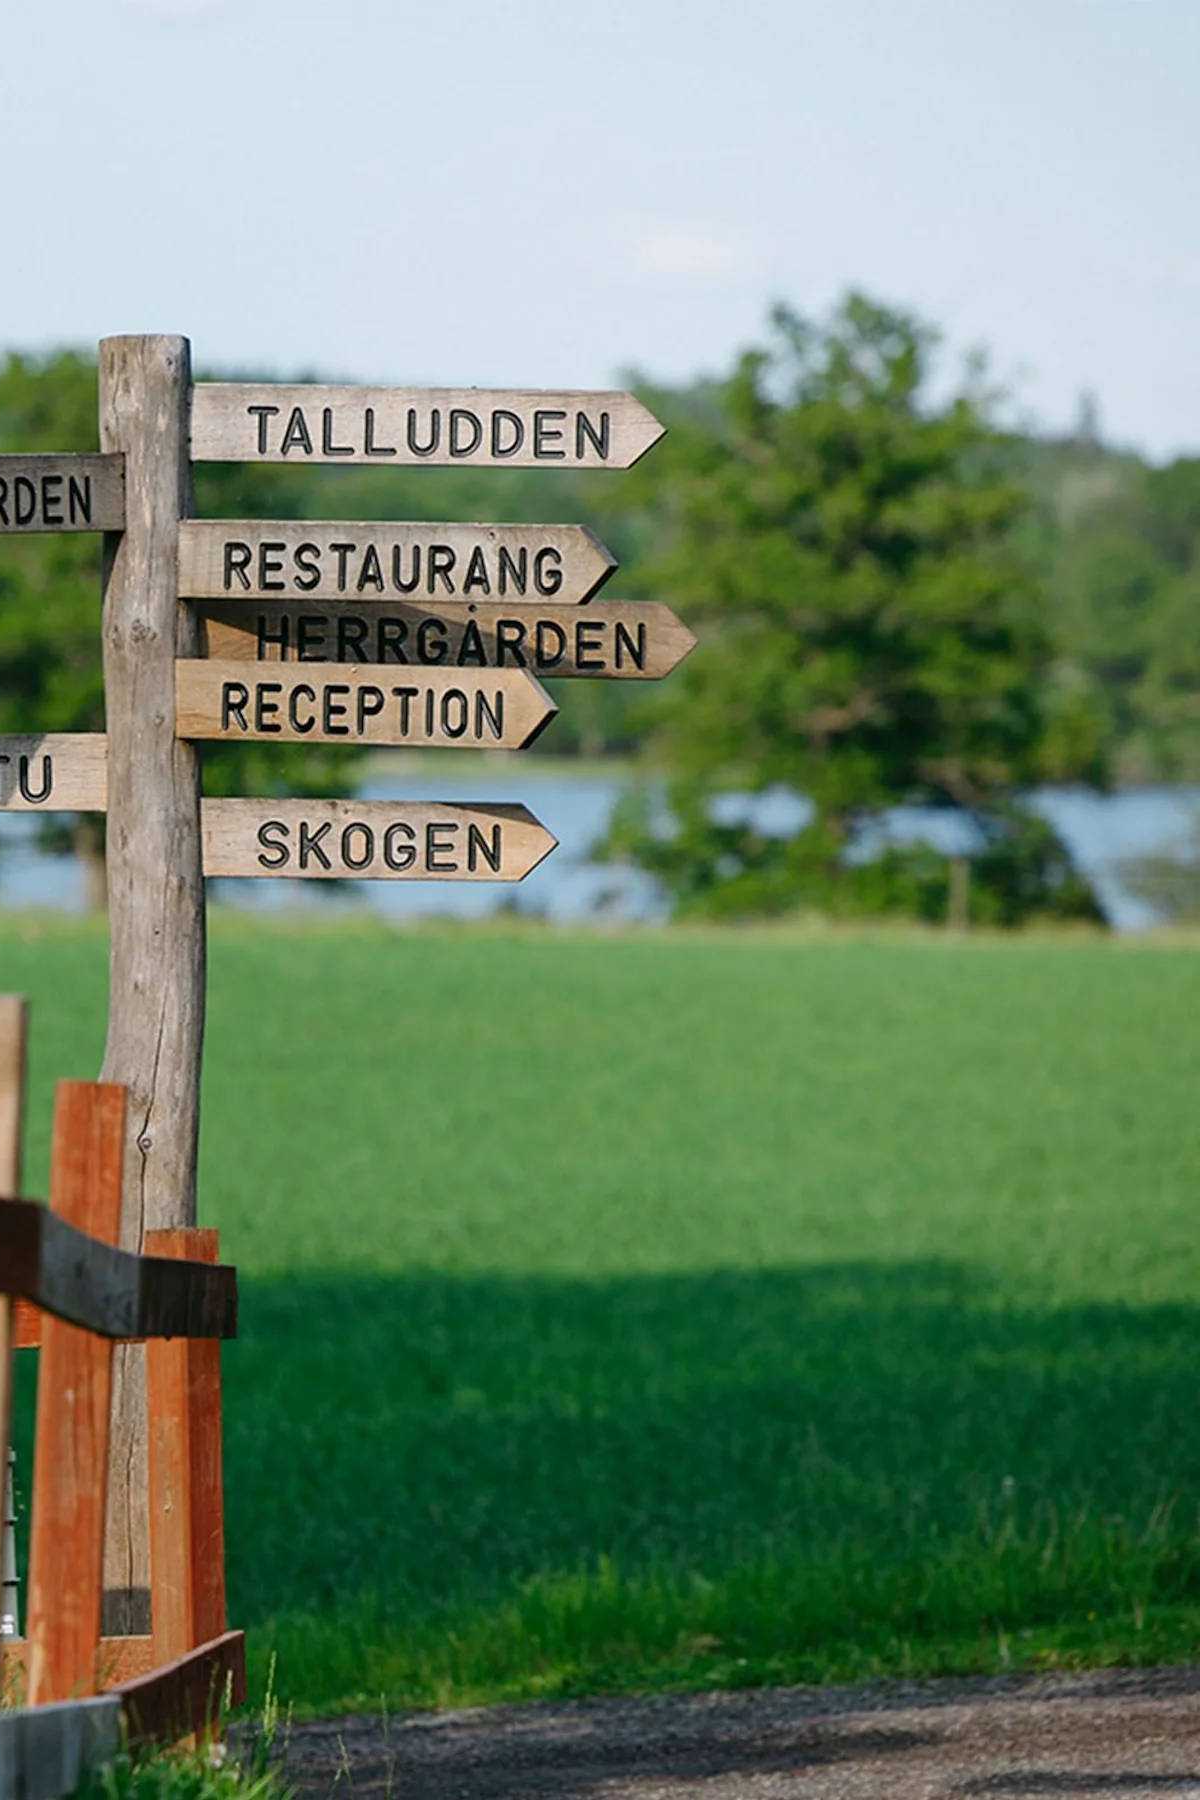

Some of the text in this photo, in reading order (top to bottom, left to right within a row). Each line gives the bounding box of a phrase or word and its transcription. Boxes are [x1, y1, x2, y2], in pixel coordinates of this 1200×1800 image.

[247, 405, 611, 461] TALLUDDEN
[224, 541, 564, 597] RESTAURANG
[257, 603, 646, 671] HERRGÅRDEN
[220, 681, 504, 740] RECEPTION
[256, 820, 503, 874] SKOGEN
